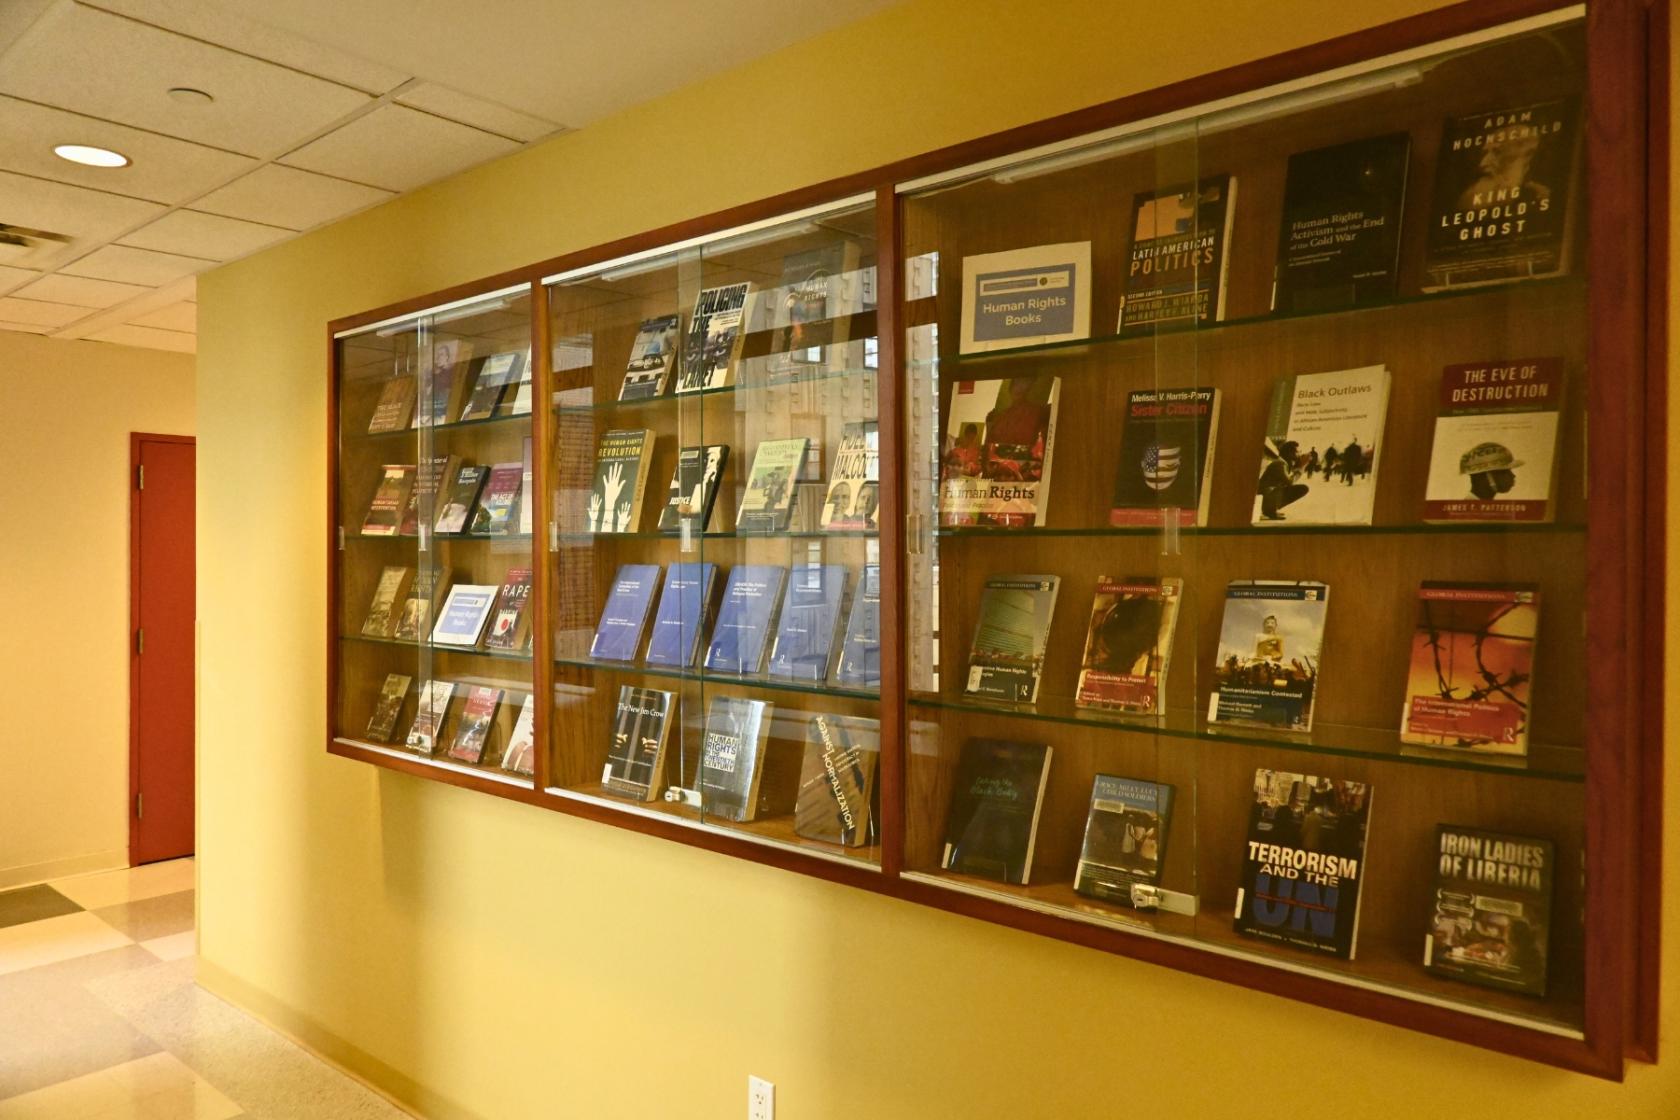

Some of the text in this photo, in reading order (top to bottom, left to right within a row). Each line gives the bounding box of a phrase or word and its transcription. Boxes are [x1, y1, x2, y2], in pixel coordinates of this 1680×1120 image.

[1484, 112, 1532, 128] ADAM
[1453, 121, 1562, 151] HOCHSCHILD
[1473, 187, 1520, 206] KING
[1292, 211, 1364, 231] Human Rights
[1442, 199, 1549, 227] LEOPOLD'S
[1291, 226, 1333, 240] Activism
[1362, 216, 1384, 228] End
[1460, 220, 1527, 240] GHOST
[1161, 236, 1215, 256] AMERICAN
[1310, 236, 1333, 248] Cold
[1335, 233, 1356, 243] War
[1130, 247, 1214, 277] POLITICS
[695, 284, 748, 317] POLICING
[983, 297, 1066, 314] Human Rights
[1005, 313, 1041, 326] Books
[1465, 365, 1538, 384] THE EVE OF
[1298, 384, 1372, 399] Black Outlaws
[1452, 383, 1549, 402] DESTRUCTION
[598, 447, 642, 457] REVOLUTION
[989, 486, 1034, 501] Rights
[502, 584, 531, 598] RAPE
[1271, 690, 1303, 698] Contested
[618, 703, 664, 718] The New Jim Crow
[1447, 708, 1471, 717] Rights
[707, 735, 736, 745] HUMAN
[815, 716, 835, 753] AGAINST
[707, 742, 736, 755] RIGHTS
[822, 752, 855, 830] NORMALIZATION
[1440, 832, 1542, 868] IRON LADIES
[1248, 840, 1358, 880] TERRORISM
[1260, 864, 1340, 888] AND THE
[1440, 854, 1540, 891] OF LIBERIA
[1252, 873, 1339, 939] UN
